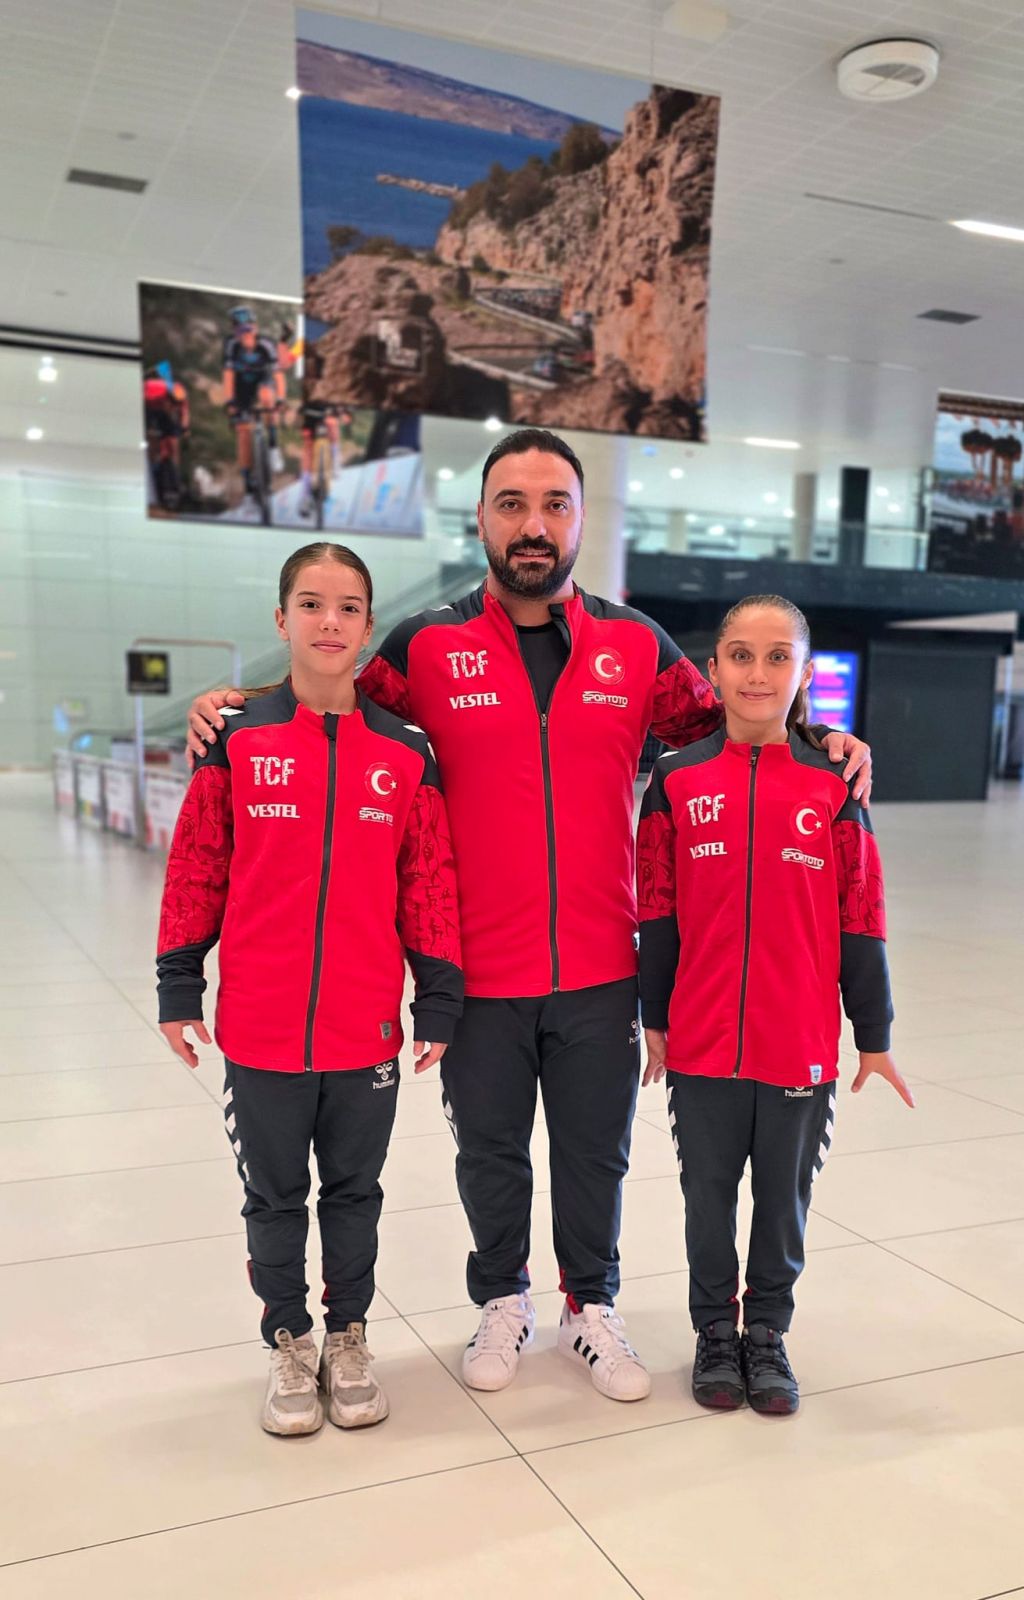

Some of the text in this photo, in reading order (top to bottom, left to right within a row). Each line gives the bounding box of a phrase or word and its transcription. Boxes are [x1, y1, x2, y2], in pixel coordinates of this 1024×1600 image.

[447, 650, 488, 679] TCF
[449, 692, 501, 709] VESTEL
[250, 756, 295, 786] TCF
[247, 803, 301, 818] VESTEL
[686, 793, 726, 826] TCF
[784, 1088, 814, 1097] hummel
